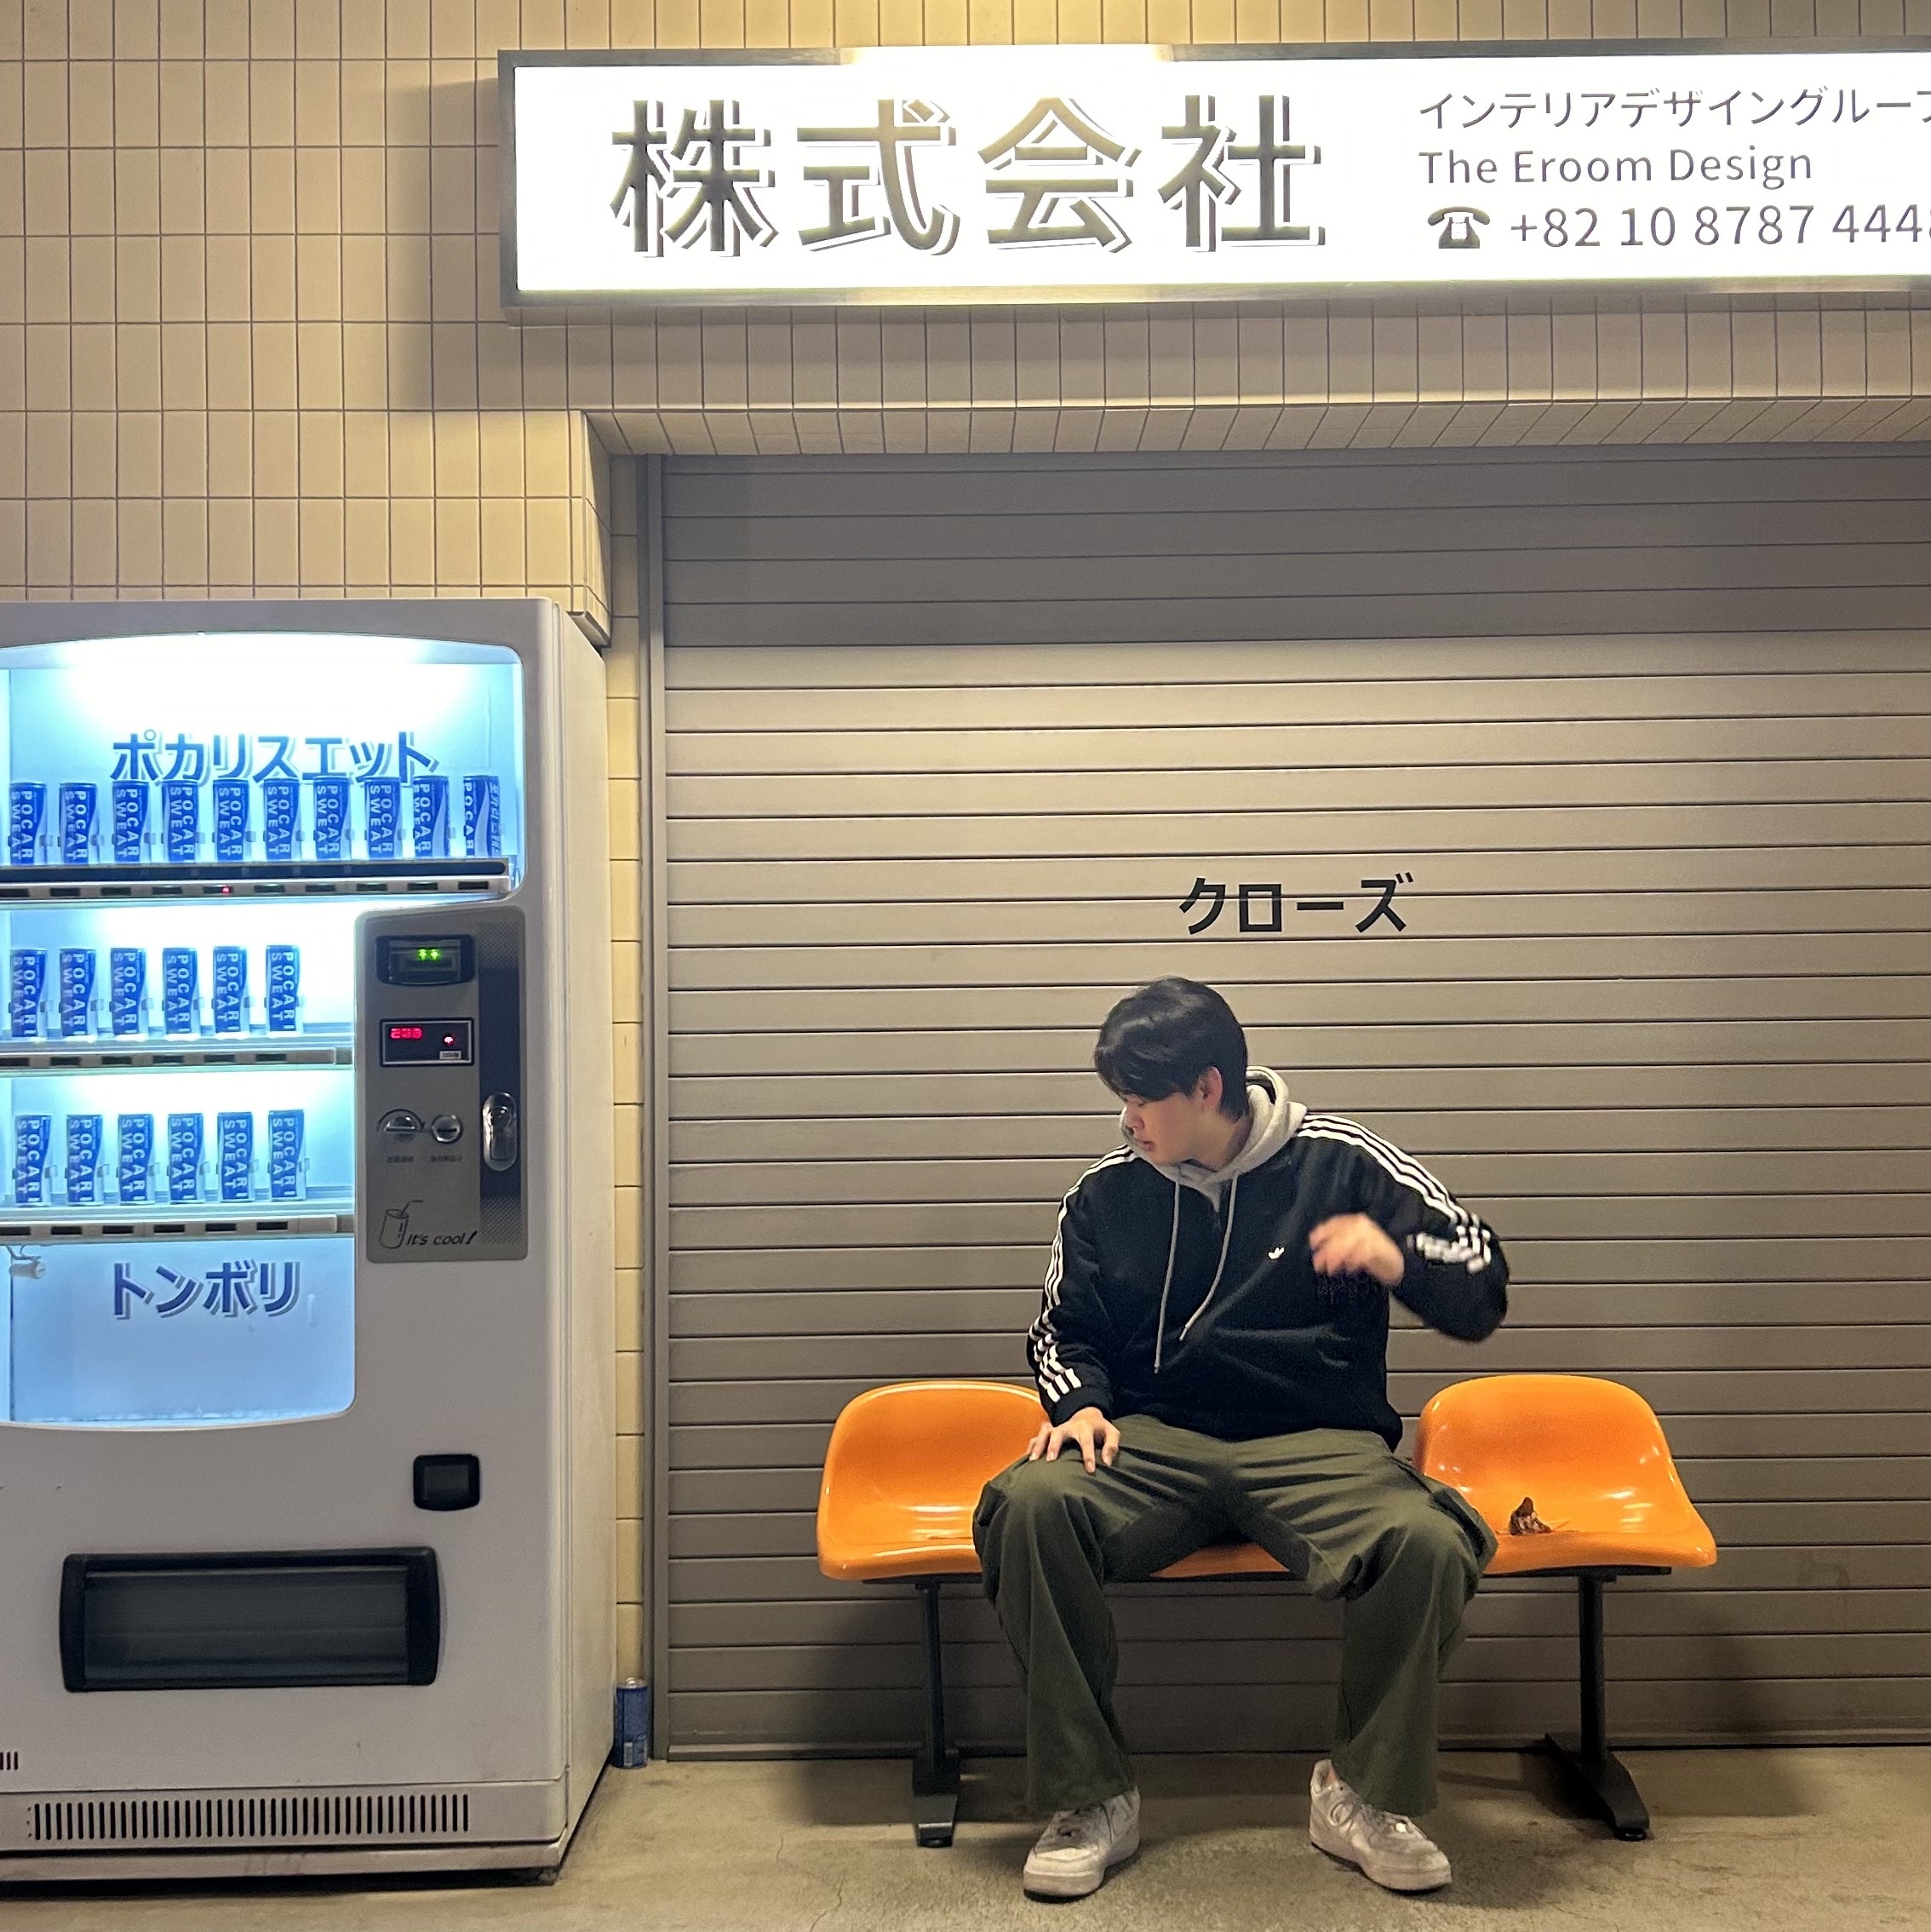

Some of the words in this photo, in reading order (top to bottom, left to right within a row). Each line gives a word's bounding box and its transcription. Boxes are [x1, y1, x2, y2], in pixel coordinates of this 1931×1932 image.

[609, 94, 1326, 257] 株式会社
[1418, 149, 1498, 184] The
[1514, 150, 1653, 183] Eroom
[1670, 145, 1813, 190] Design
[1510, 207, 1602, 248] +82
[1620, 206, 1676, 247] 10
[1693, 204, 1815, 246] 8787
[1831, 204, 1931, 244] 444
[110, 729, 438, 787] ポカリスエット
[1178, 872, 1414, 935] クローズ
[24, 956, 37, 1035] POCARI
[72, 954, 86, 1035] POCARI
[123, 952, 137, 1034] POCARI
[177, 955, 190, 1032] POCARI
[226, 953, 239, 1030] POCARI
[283, 952, 295, 1029] POCARI
[27, 1120, 40, 1202] POCARI
[79, 1119, 93, 1201] POCARI
[133, 1119, 146, 1201] POCARI
[182, 1117, 195, 1200] POCARI
[235, 1119, 248, 1197] POCARI
[283, 1117, 295, 1195] POCARI
[114, 1259, 300, 1320] トンボリ
